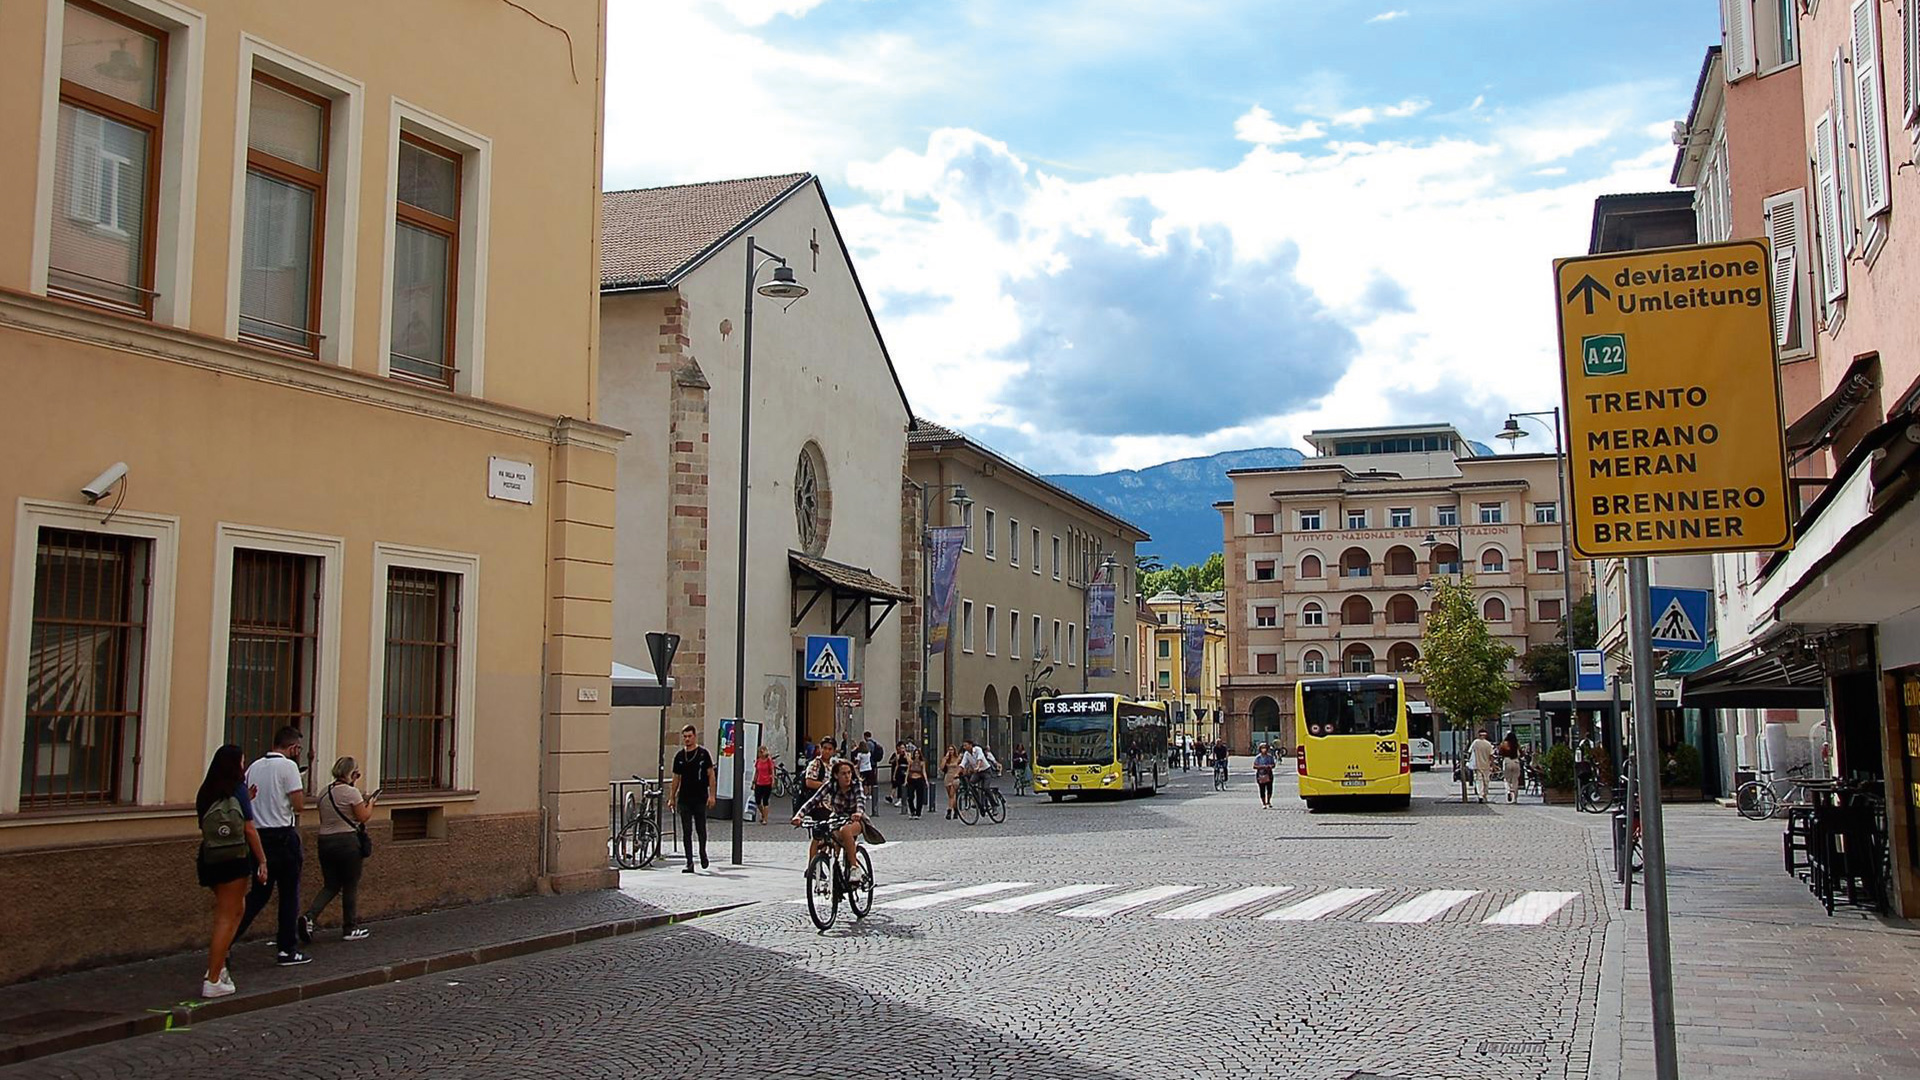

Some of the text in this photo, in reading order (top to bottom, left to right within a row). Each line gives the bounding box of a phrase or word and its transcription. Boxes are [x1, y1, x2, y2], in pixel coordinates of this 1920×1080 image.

[1614, 260, 1759, 287] deviazione
[1617, 286, 1762, 314] Umleitung
[1588, 345, 1623, 364] A 22
[1585, 386, 1708, 414] TRENTO
[1588, 423, 1719, 451] MERANO
[1590, 452, 1697, 478] MERAN
[1592, 486, 1765, 516] BRENNERO
[1342, 532, 1395, 541] NAZIONALE
[1594, 516, 1744, 544] BRENNER
